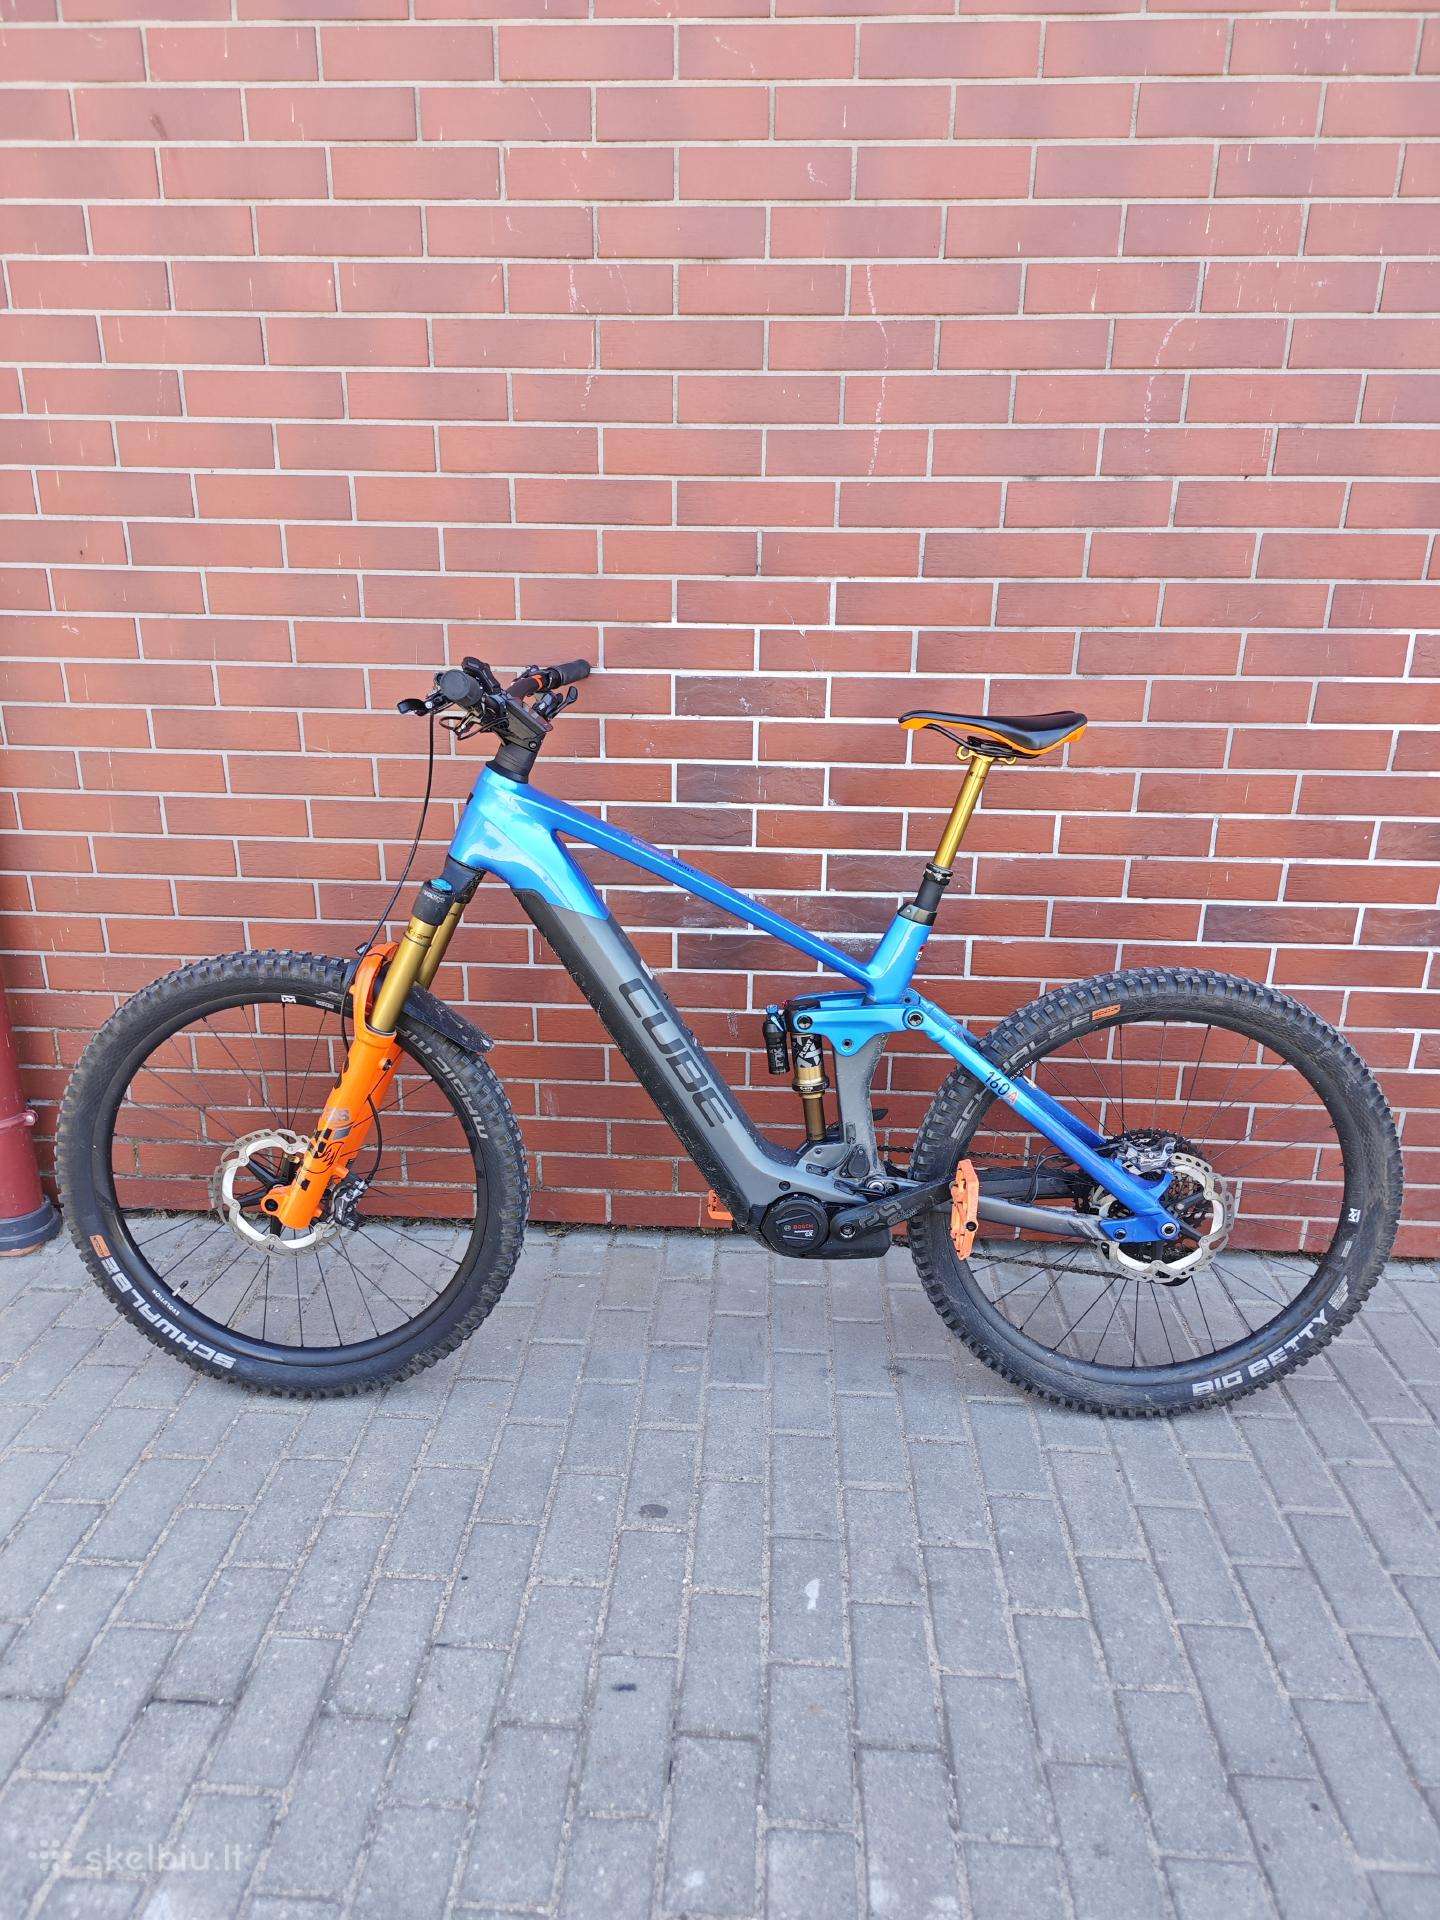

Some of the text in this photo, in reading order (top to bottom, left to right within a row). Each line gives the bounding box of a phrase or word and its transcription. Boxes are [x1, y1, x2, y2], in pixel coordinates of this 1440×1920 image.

[618, 977, 734, 1128] CUBE
[984, 1071, 1010, 1096] 160
[1008, 1059, 1035, 1081] OLUTION
[431, 1056, 489, 1139] MAGIC
[100, 1256, 237, 1370] SCHWALBE
[151, 1288, 180, 1317] EVOLUTION
[1192, 1308, 1329, 1397] BIG BETTY
